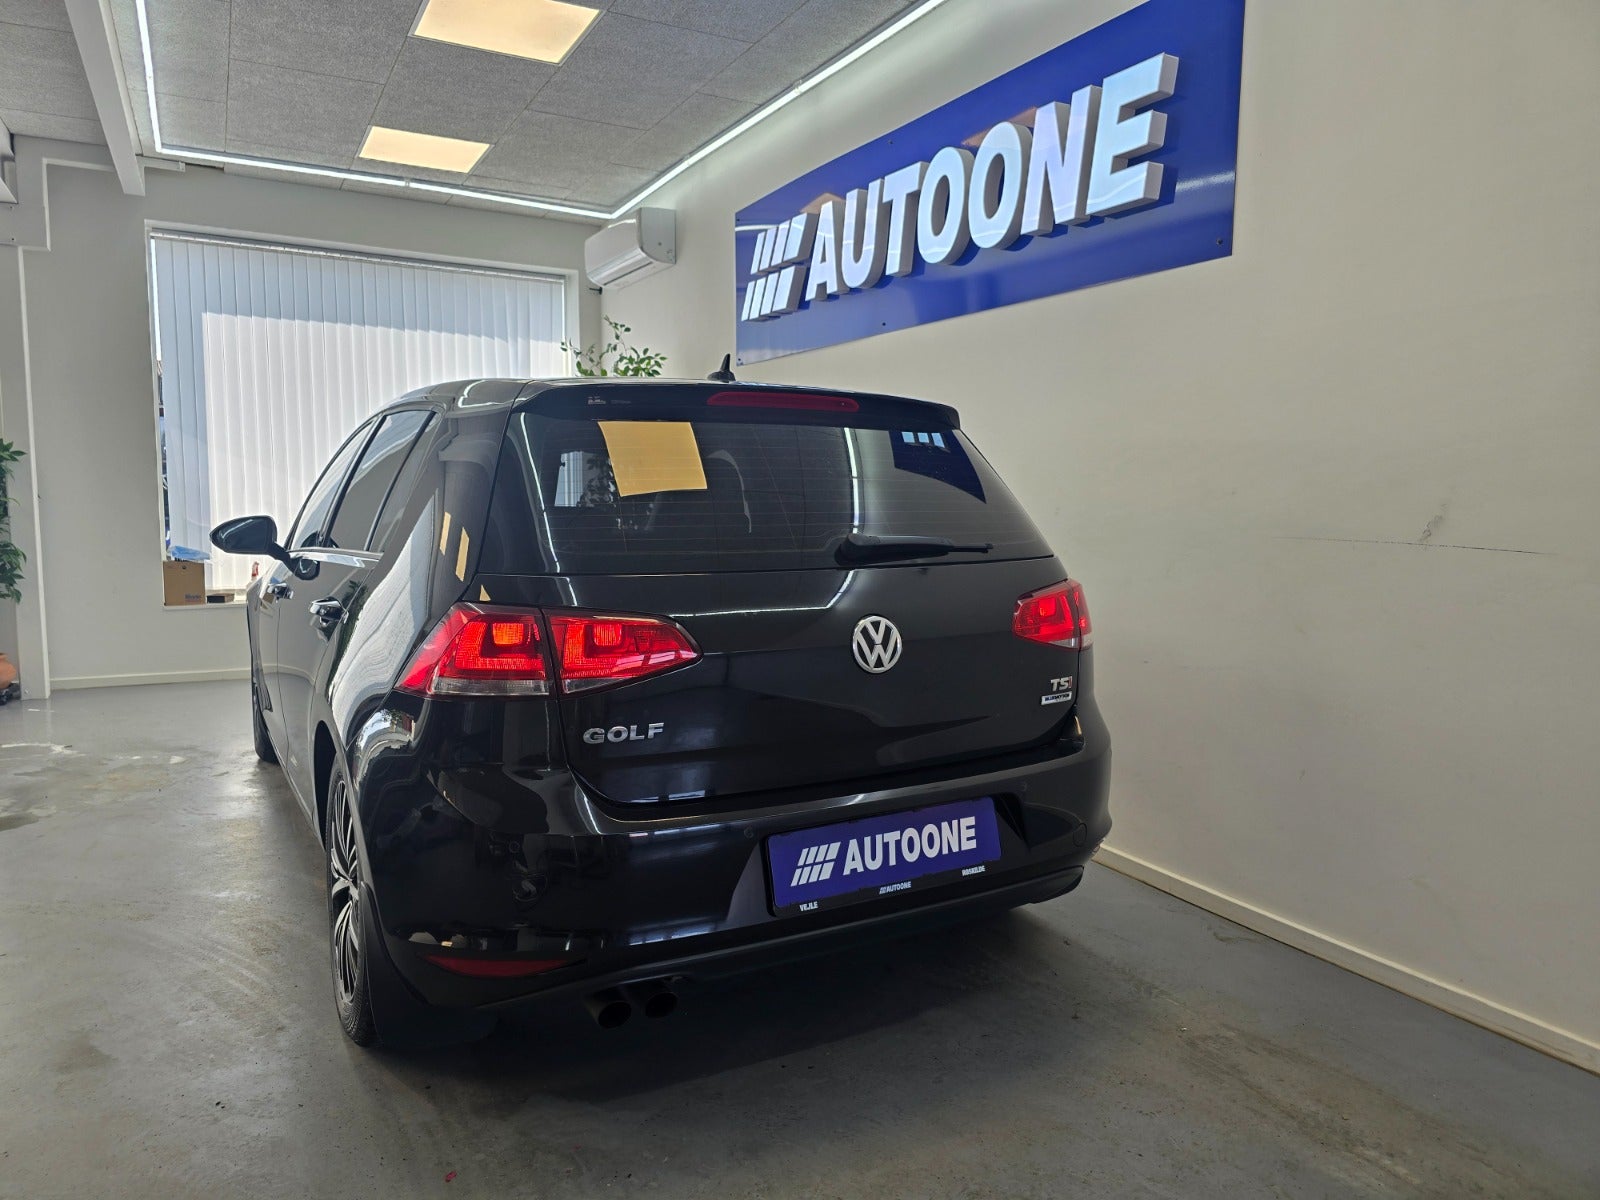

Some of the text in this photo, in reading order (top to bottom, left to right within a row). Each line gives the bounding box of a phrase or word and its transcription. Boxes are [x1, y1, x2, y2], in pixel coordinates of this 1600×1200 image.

[805, 52, 1180, 301] AUTOONE
[583, 722, 664, 744] GOLF
[843, 816, 976, 876] AUTOONE
[886, 881, 912, 893] AUTOONE
[799, 901, 818, 912] VEJLE
